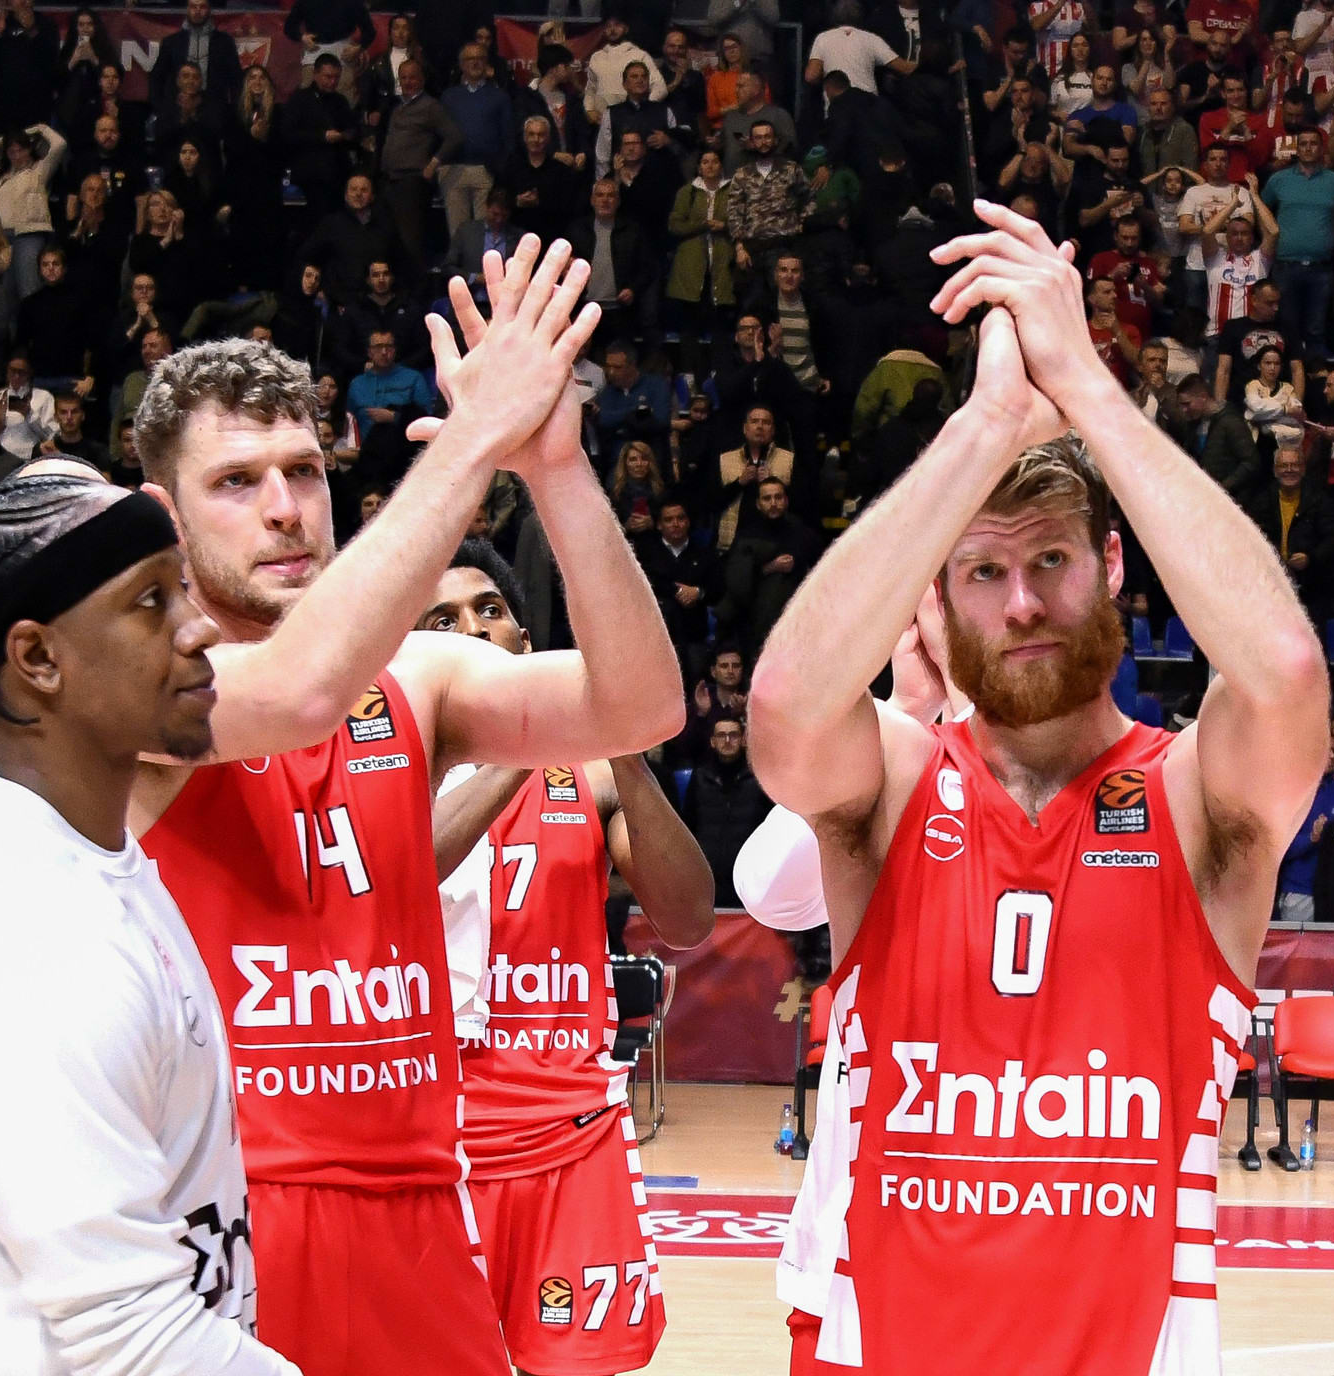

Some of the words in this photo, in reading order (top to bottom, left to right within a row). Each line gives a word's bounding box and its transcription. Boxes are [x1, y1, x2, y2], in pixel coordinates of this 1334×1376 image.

[1099, 809, 1144, 818] TURKISH
[1099, 816, 1144, 825] AIRLINES
[1083, 850, 1157, 866] oneteam
[990, 888, 1054, 998] 0
[880, 1173, 1157, 1219] FOUNDATION
[582, 1260, 650, 1331] 77
